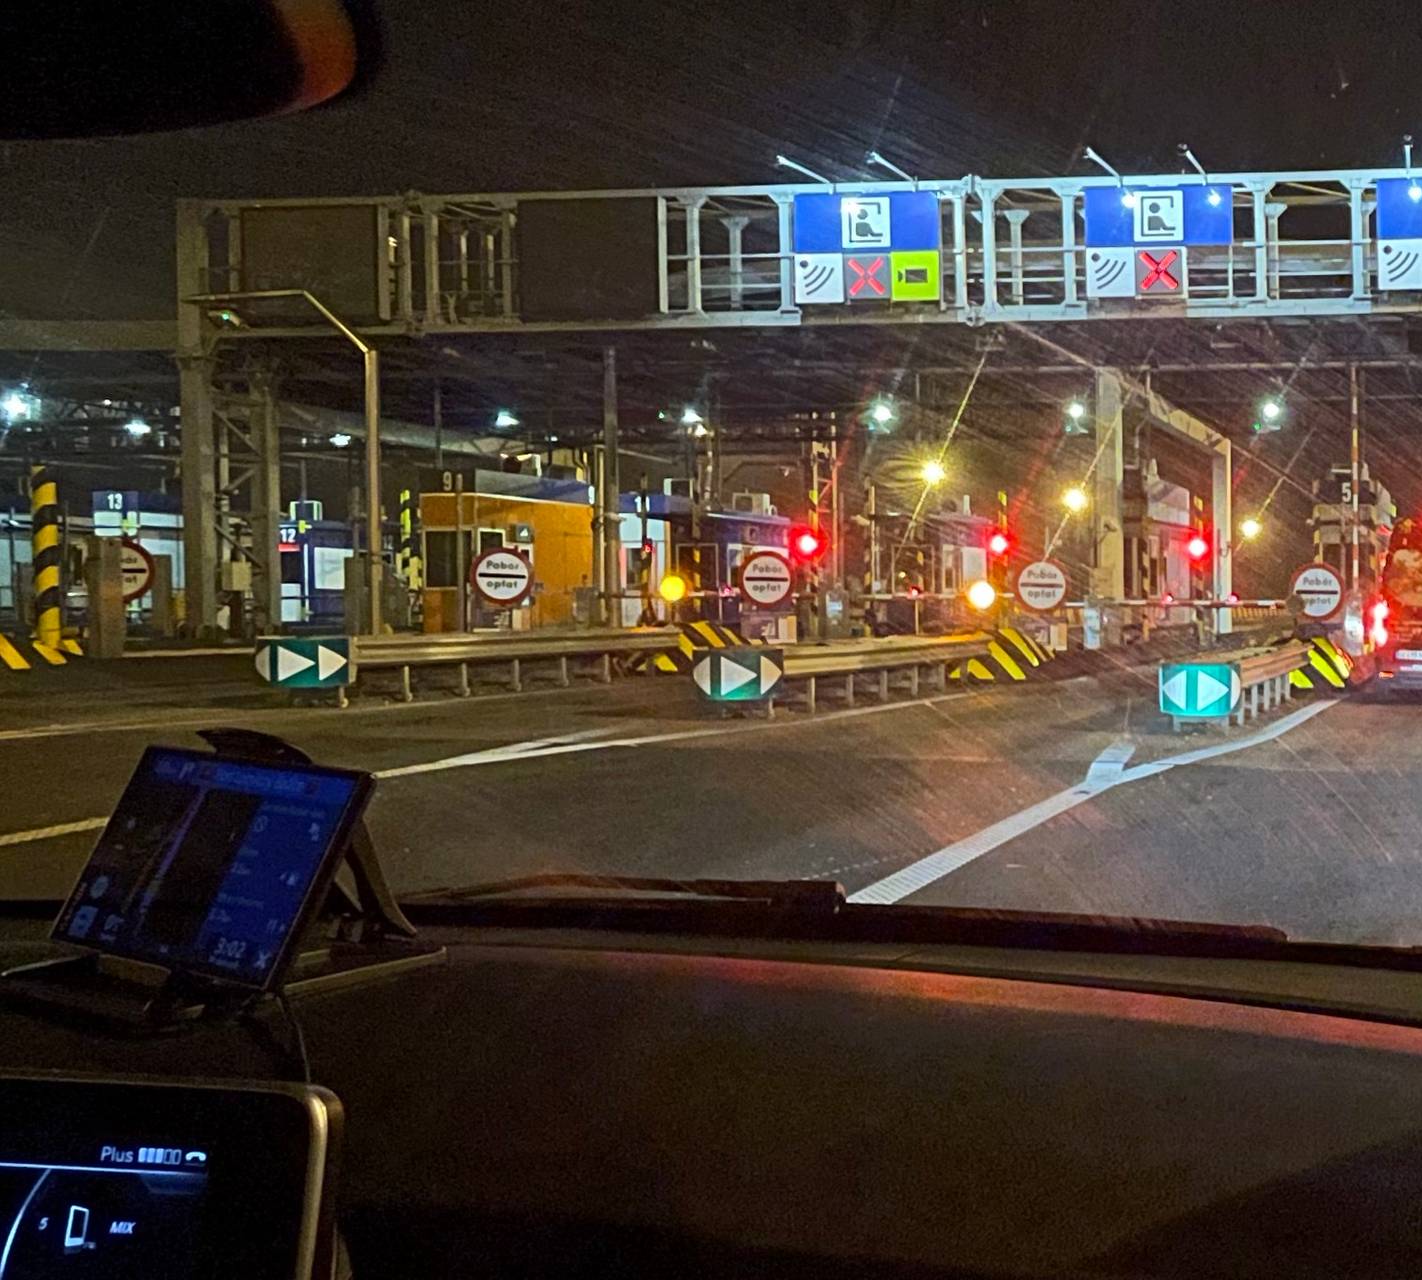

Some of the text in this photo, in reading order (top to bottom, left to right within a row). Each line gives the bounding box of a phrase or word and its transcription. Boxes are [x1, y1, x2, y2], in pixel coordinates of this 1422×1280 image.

[443, 471, 453, 491] 9
[1342, 482, 1351, 502] 5
[107, 493, 122, 510] 13
[280, 528, 296, 542] 12
[100, 1146, 134, 1163] Plus
[38, 1217, 49, 1231] 5
[108, 1221, 137, 1234] MIX
